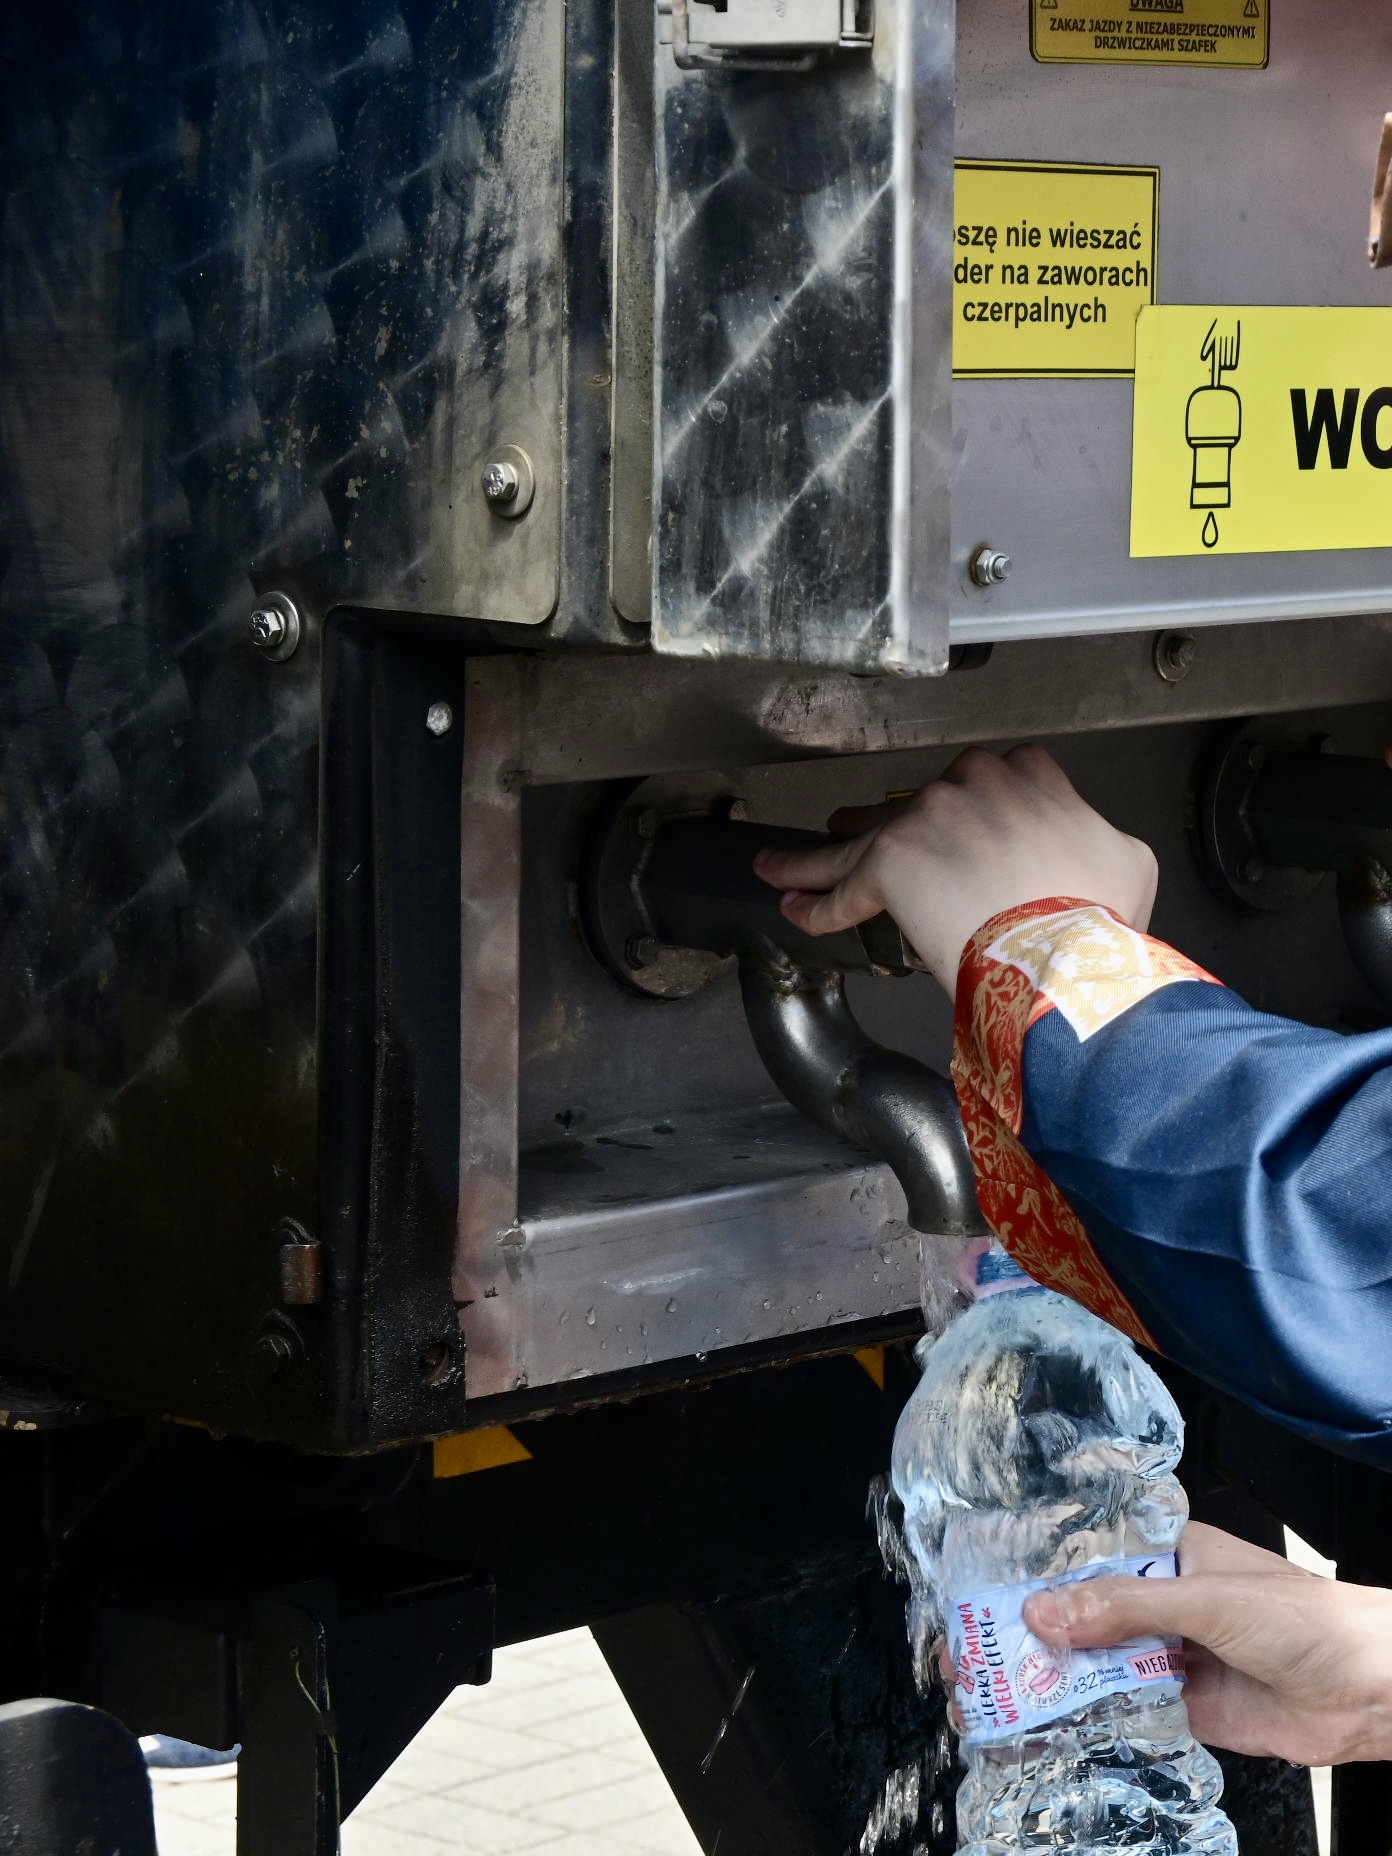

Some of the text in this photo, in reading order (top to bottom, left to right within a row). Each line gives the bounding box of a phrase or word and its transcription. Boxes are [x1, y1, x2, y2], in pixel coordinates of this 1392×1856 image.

[1050, 18, 1256, 39] ZAKAZ JAZDY Z NIEZABEZPIECZONYMI
[1094, 35, 1217, 53] DRZWICZKAMI SZAFEK
[954, 220, 1142, 254] szę nie wieszać
[954, 256, 1149, 287] der na zaworach
[962, 295, 1107, 330] czerpalnych
[957, 1602, 998, 1716] LEKKA ZMIANA
[979, 1620, 1020, 1725] WIELKI EFEKT
